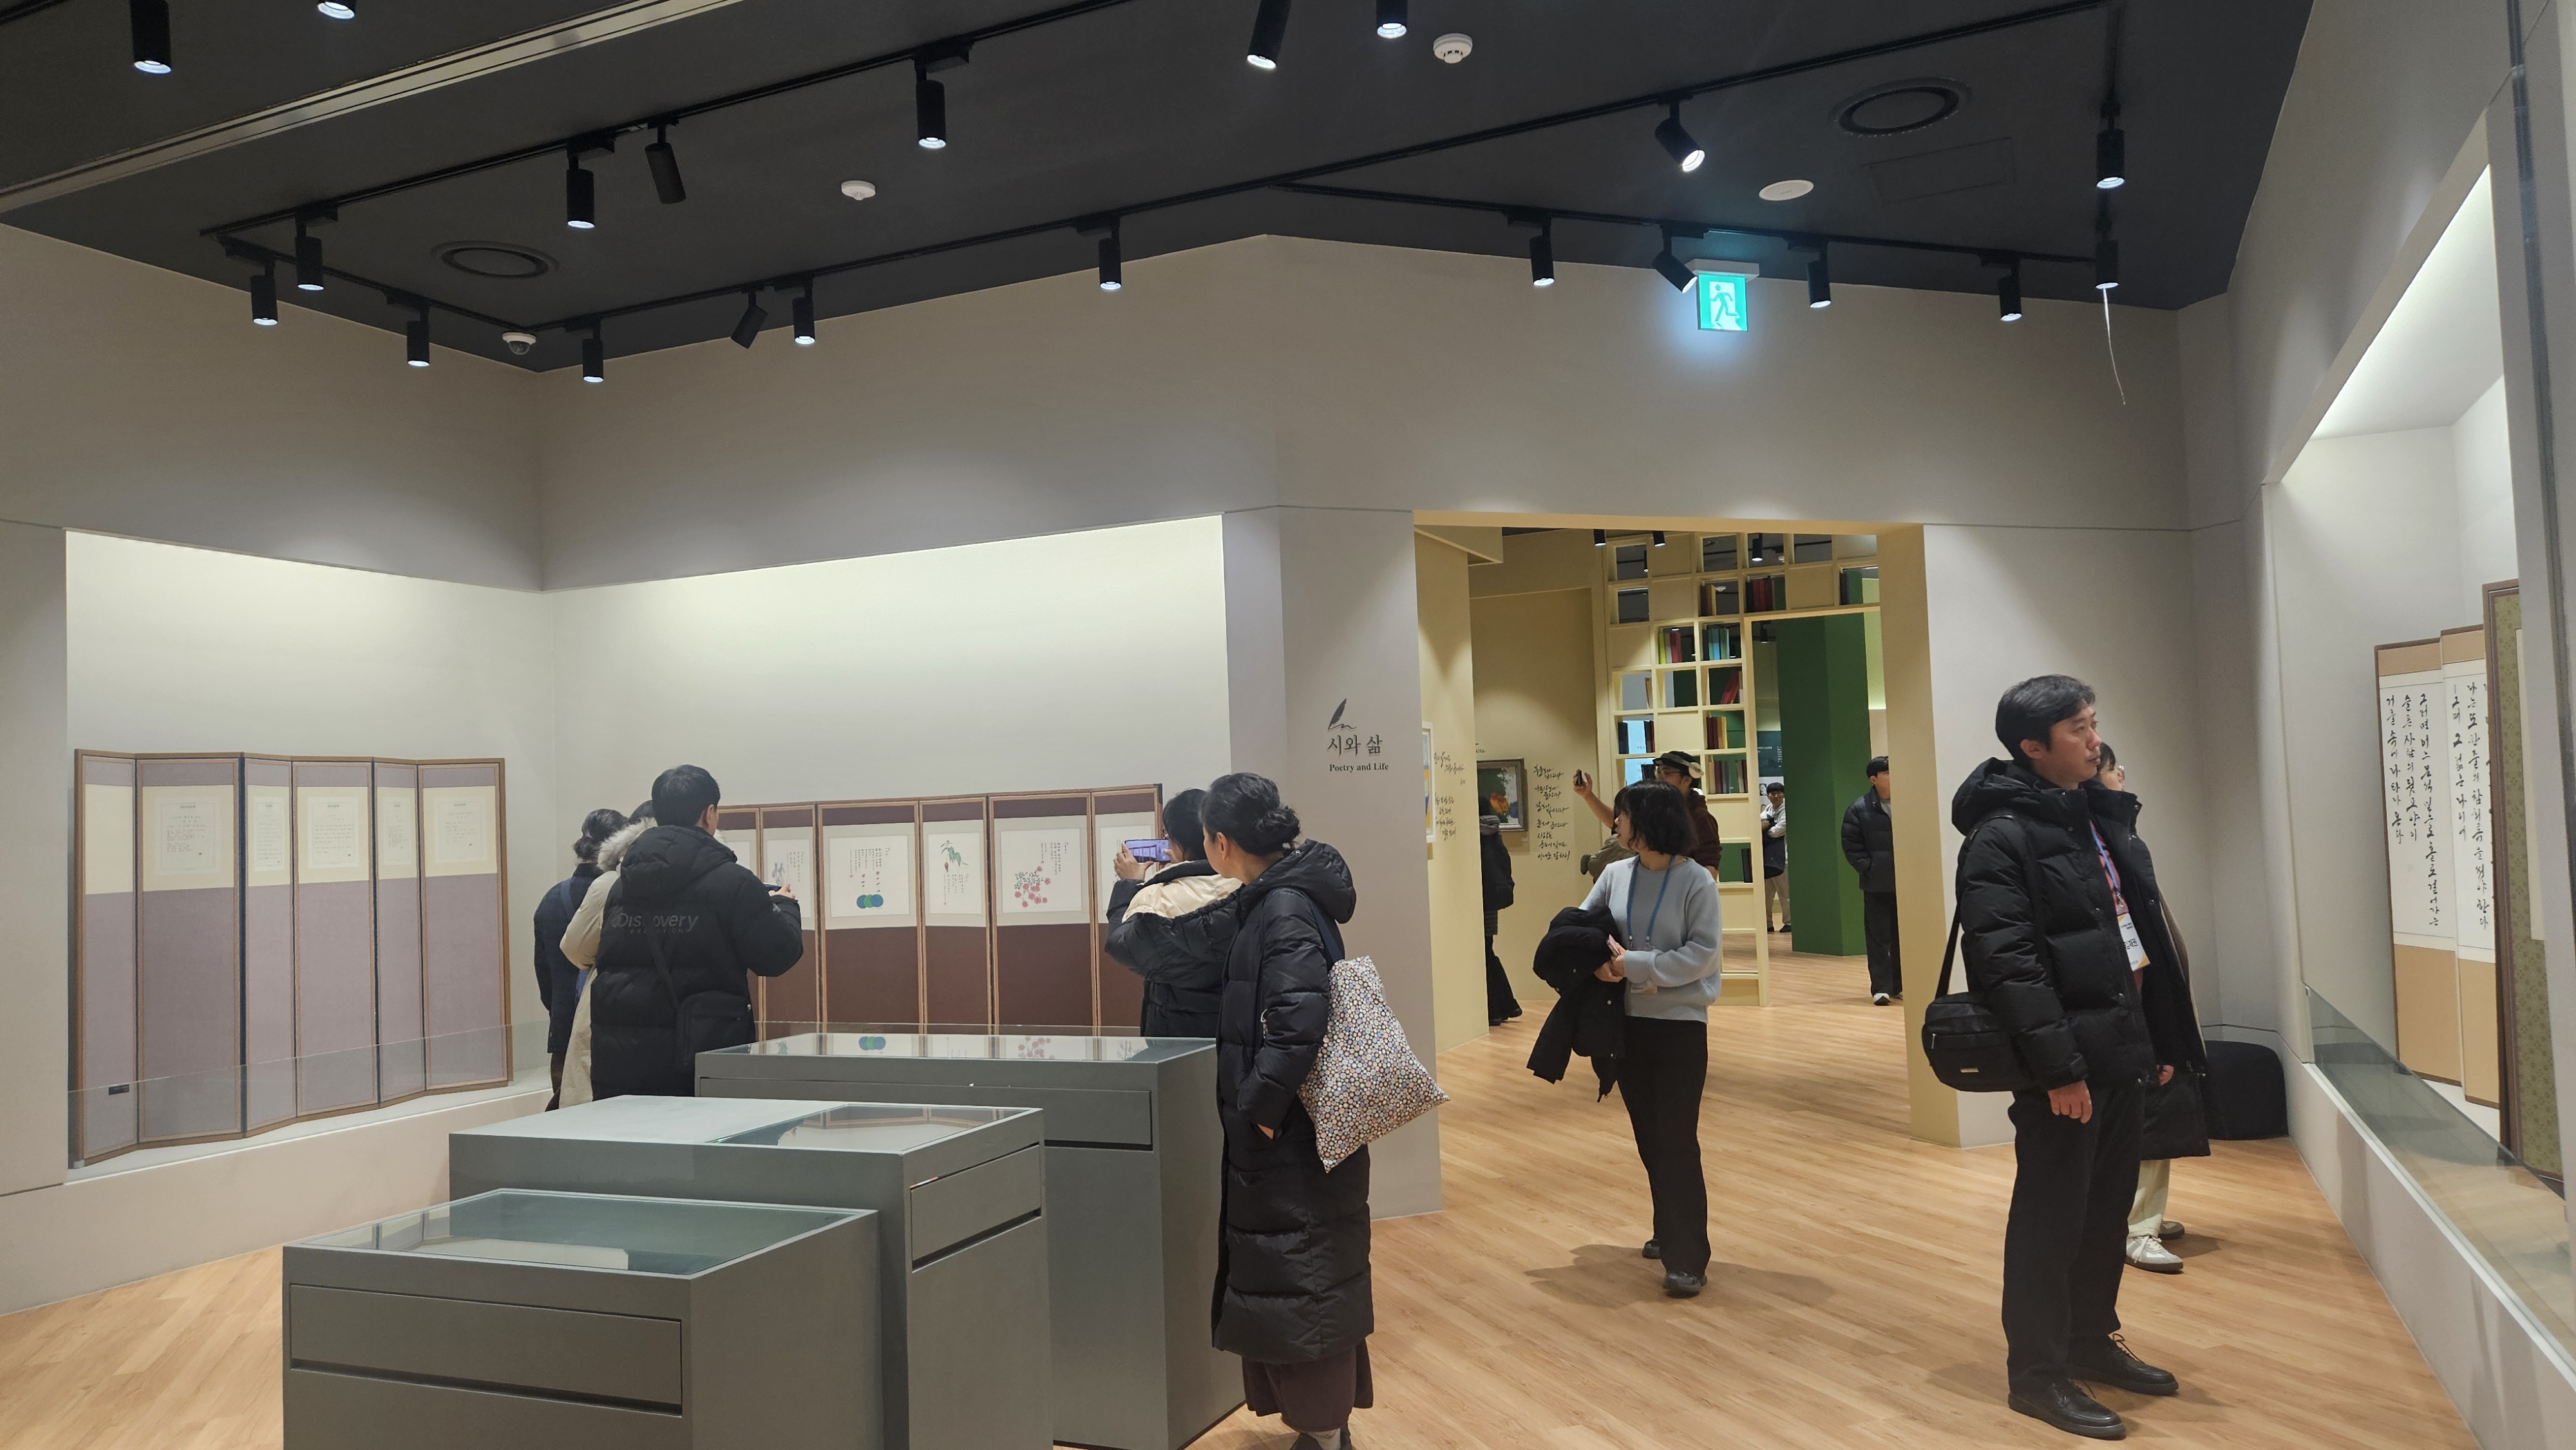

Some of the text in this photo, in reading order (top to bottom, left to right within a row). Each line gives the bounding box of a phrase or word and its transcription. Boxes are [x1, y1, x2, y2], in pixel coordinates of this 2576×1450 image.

[1327, 734, 1383, 755] 시와 삶
[1329, 764, 1354, 773] Poetry
[618, 912, 699, 932] Disovery
